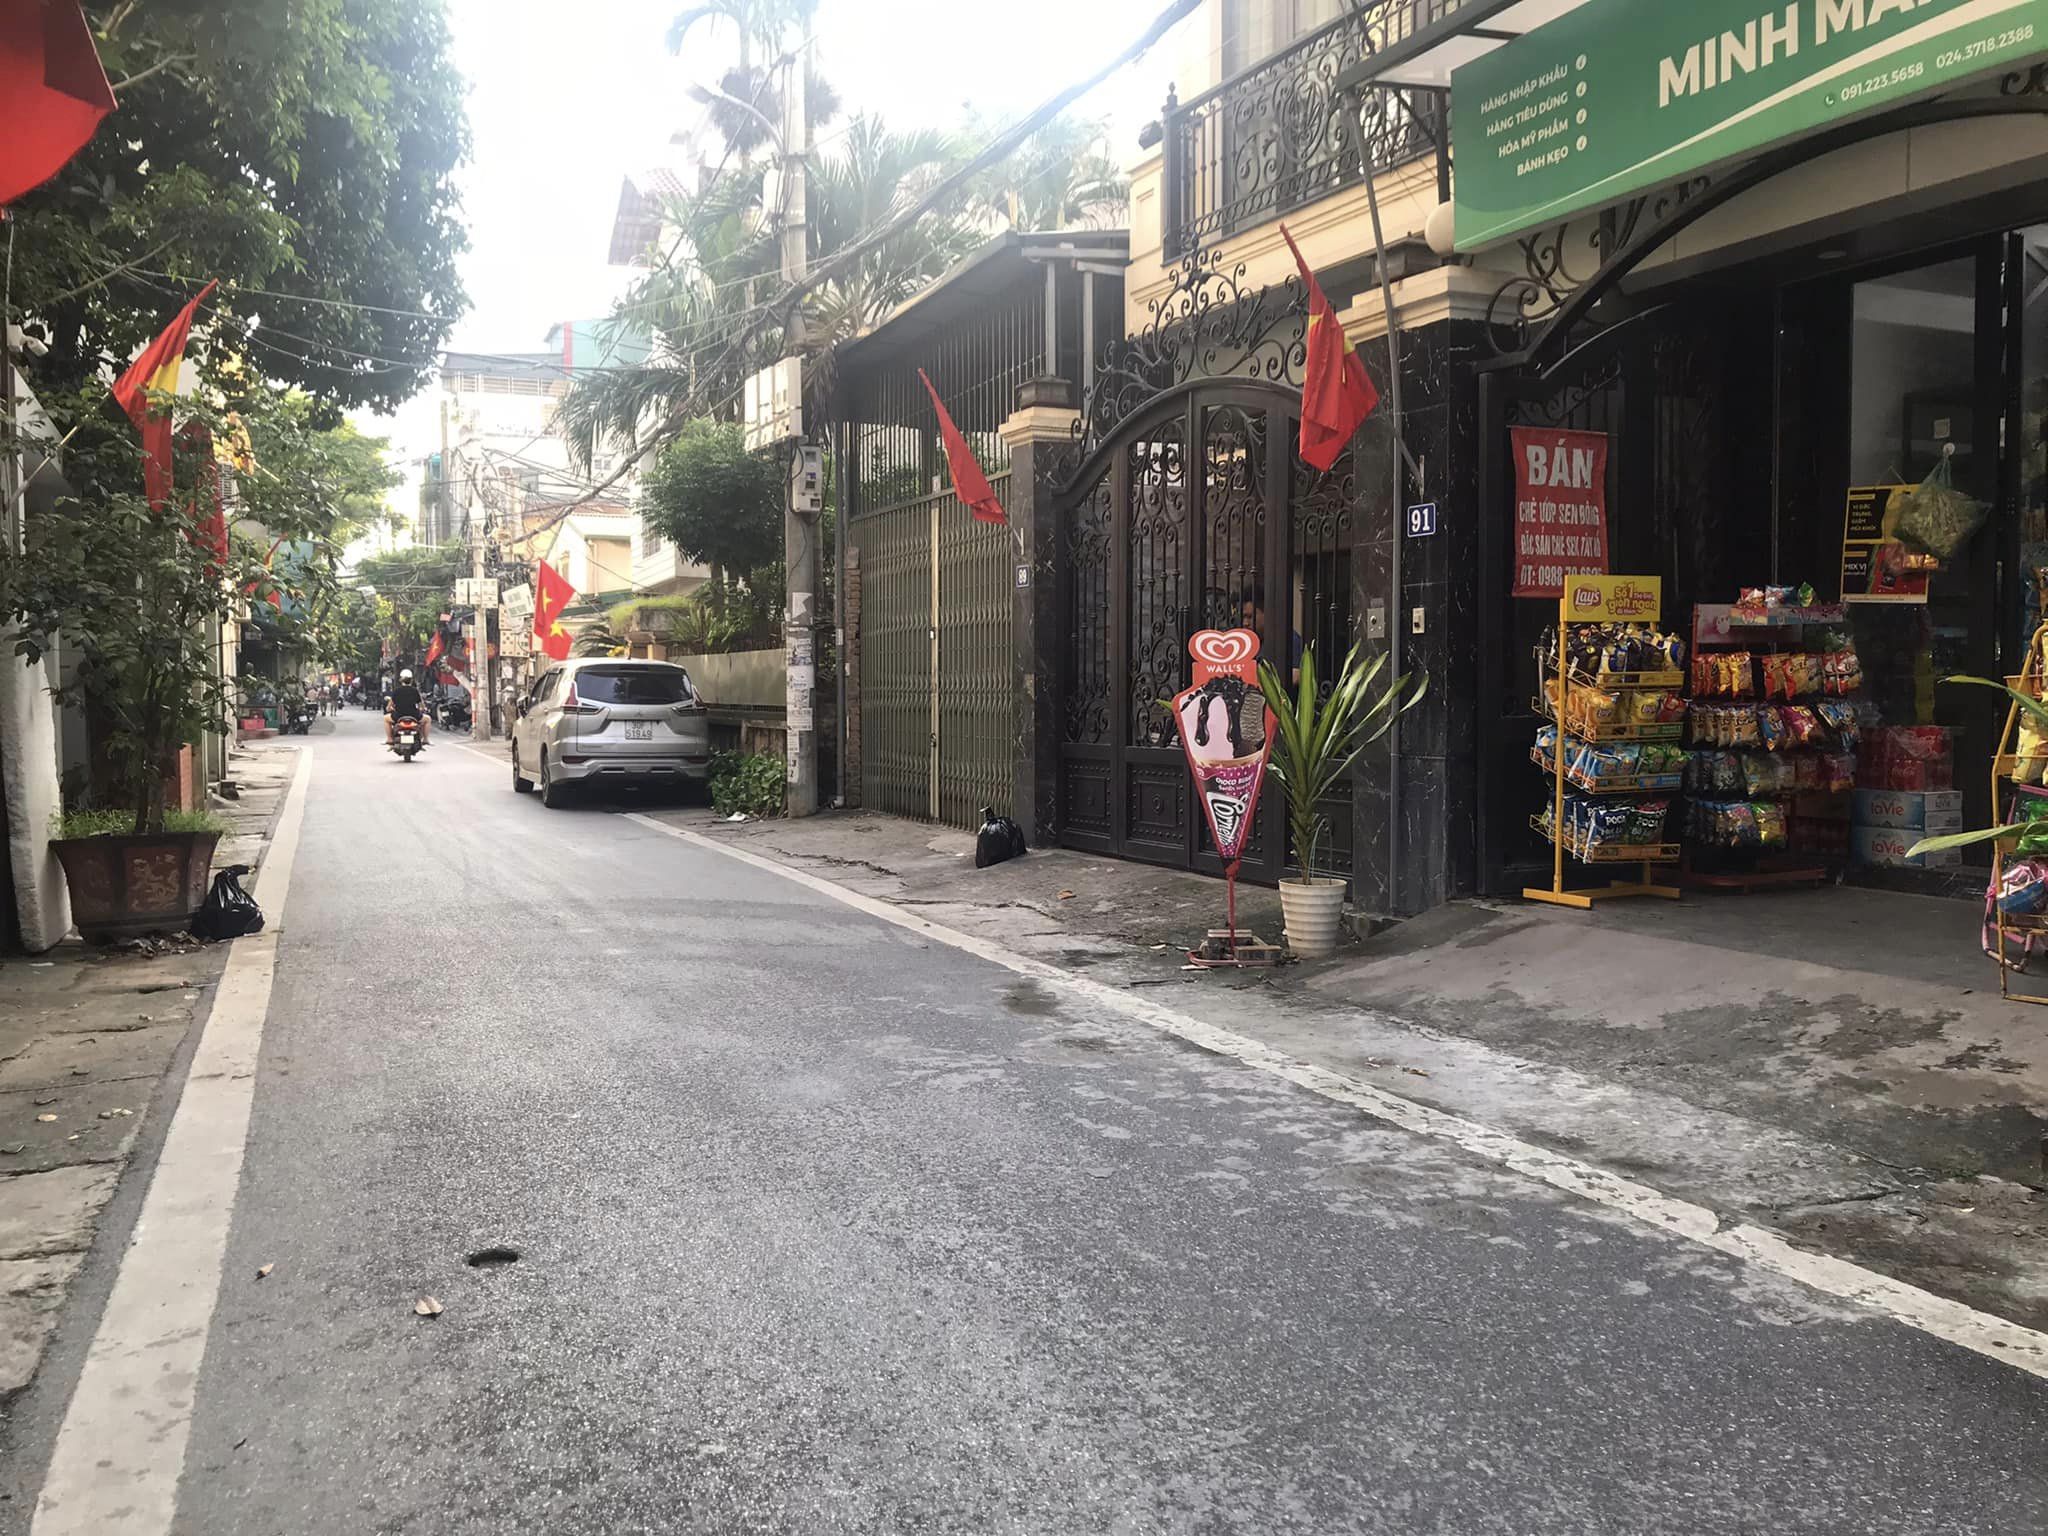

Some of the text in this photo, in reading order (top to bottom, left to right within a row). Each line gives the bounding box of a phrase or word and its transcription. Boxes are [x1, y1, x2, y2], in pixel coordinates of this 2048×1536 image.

[1659, 0, 1933, 108] MINH MA
[1841, 24, 2034, 101] 091.223.5658 024.3718.2388
[1481, 93, 1508, 114] HÀNG
[1509, 80, 1537, 102] NHẬP
[1487, 91, 1568, 137] HÀNG TIÊU DÙNG
[1517, 145, 1568, 176] BÁNH KẸO
[1526, 438, 1594, 489] BÁN
[1411, 508, 1430, 533] 91
[1520, 497, 1537, 523] CHÈ
[1559, 503, 1578, 525] SEN
[1538, 565, 1563, 586] 0988
[1206, 664, 1242, 673] WALL'S
